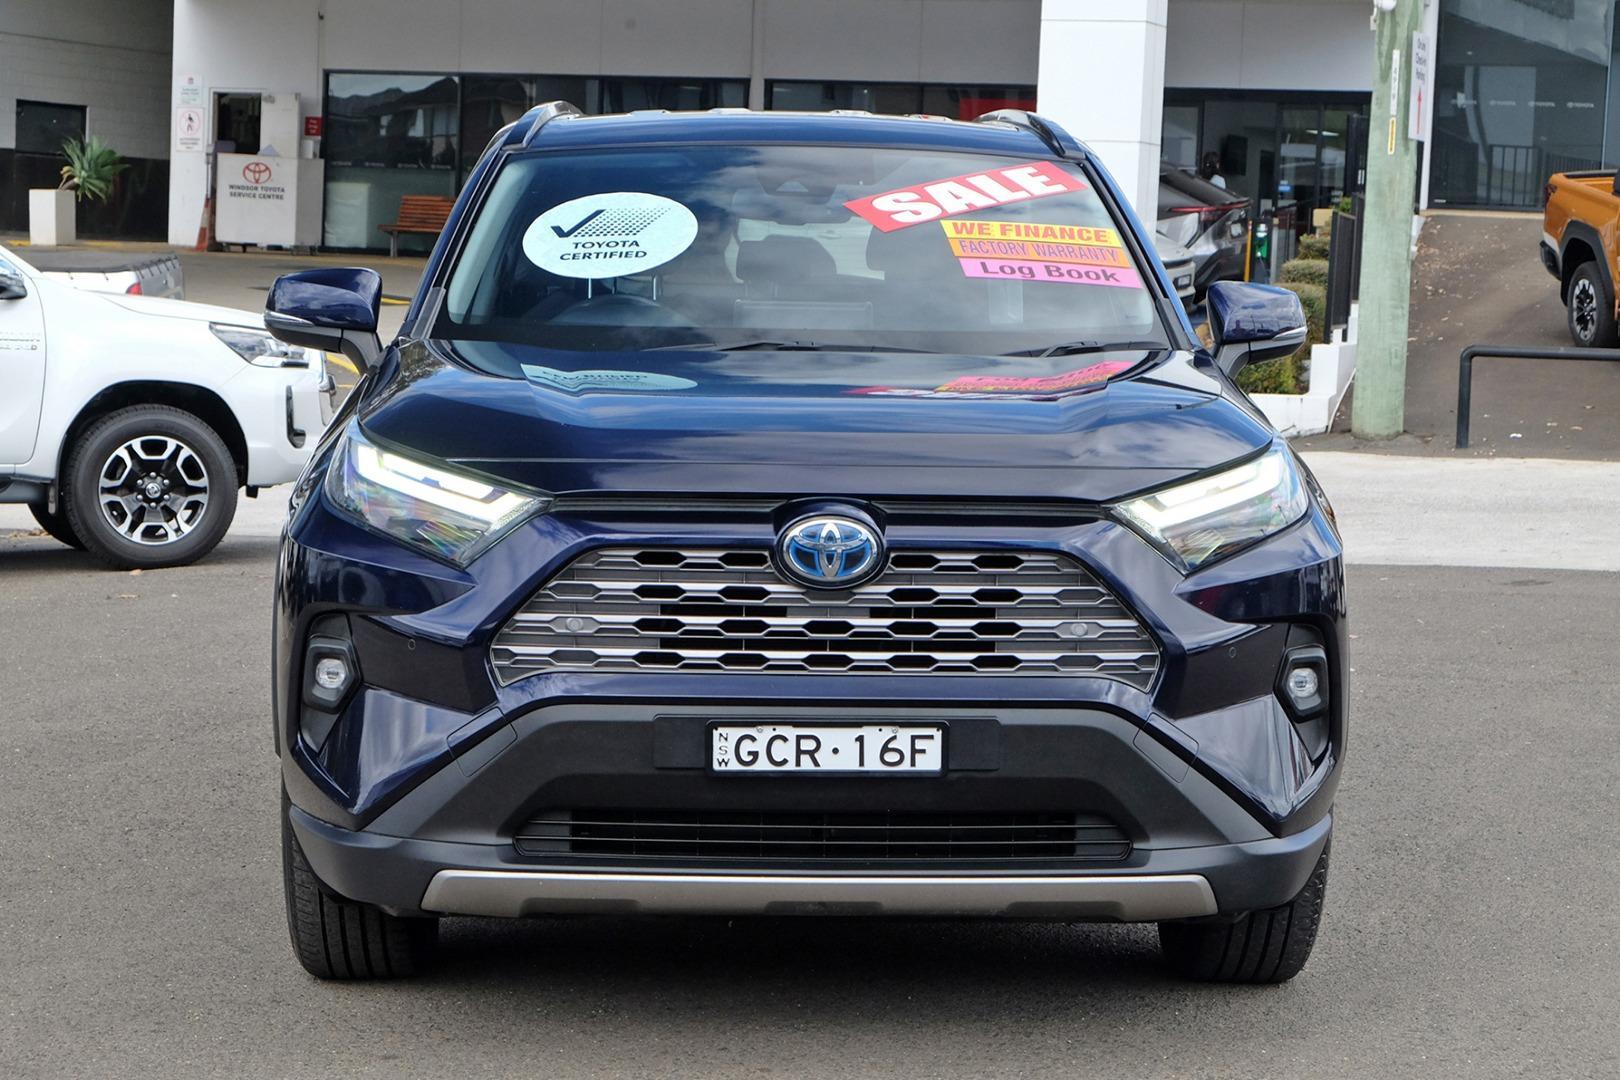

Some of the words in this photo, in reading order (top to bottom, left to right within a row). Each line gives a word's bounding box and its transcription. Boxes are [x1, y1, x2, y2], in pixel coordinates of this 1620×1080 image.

[872, 166, 1068, 222] SALE
[952, 222, 991, 236] WE
[1001, 224, 1109, 242] FINANCE
[572, 240, 640, 249] TOYOTA
[958, 239, 1026, 256] FACTORY
[1032, 243, 1118, 262] WARRANTY
[559, 250, 648, 261] CERTIFIED
[980, 261, 1035, 279] Log
[1044, 264, 1121, 283] Book
